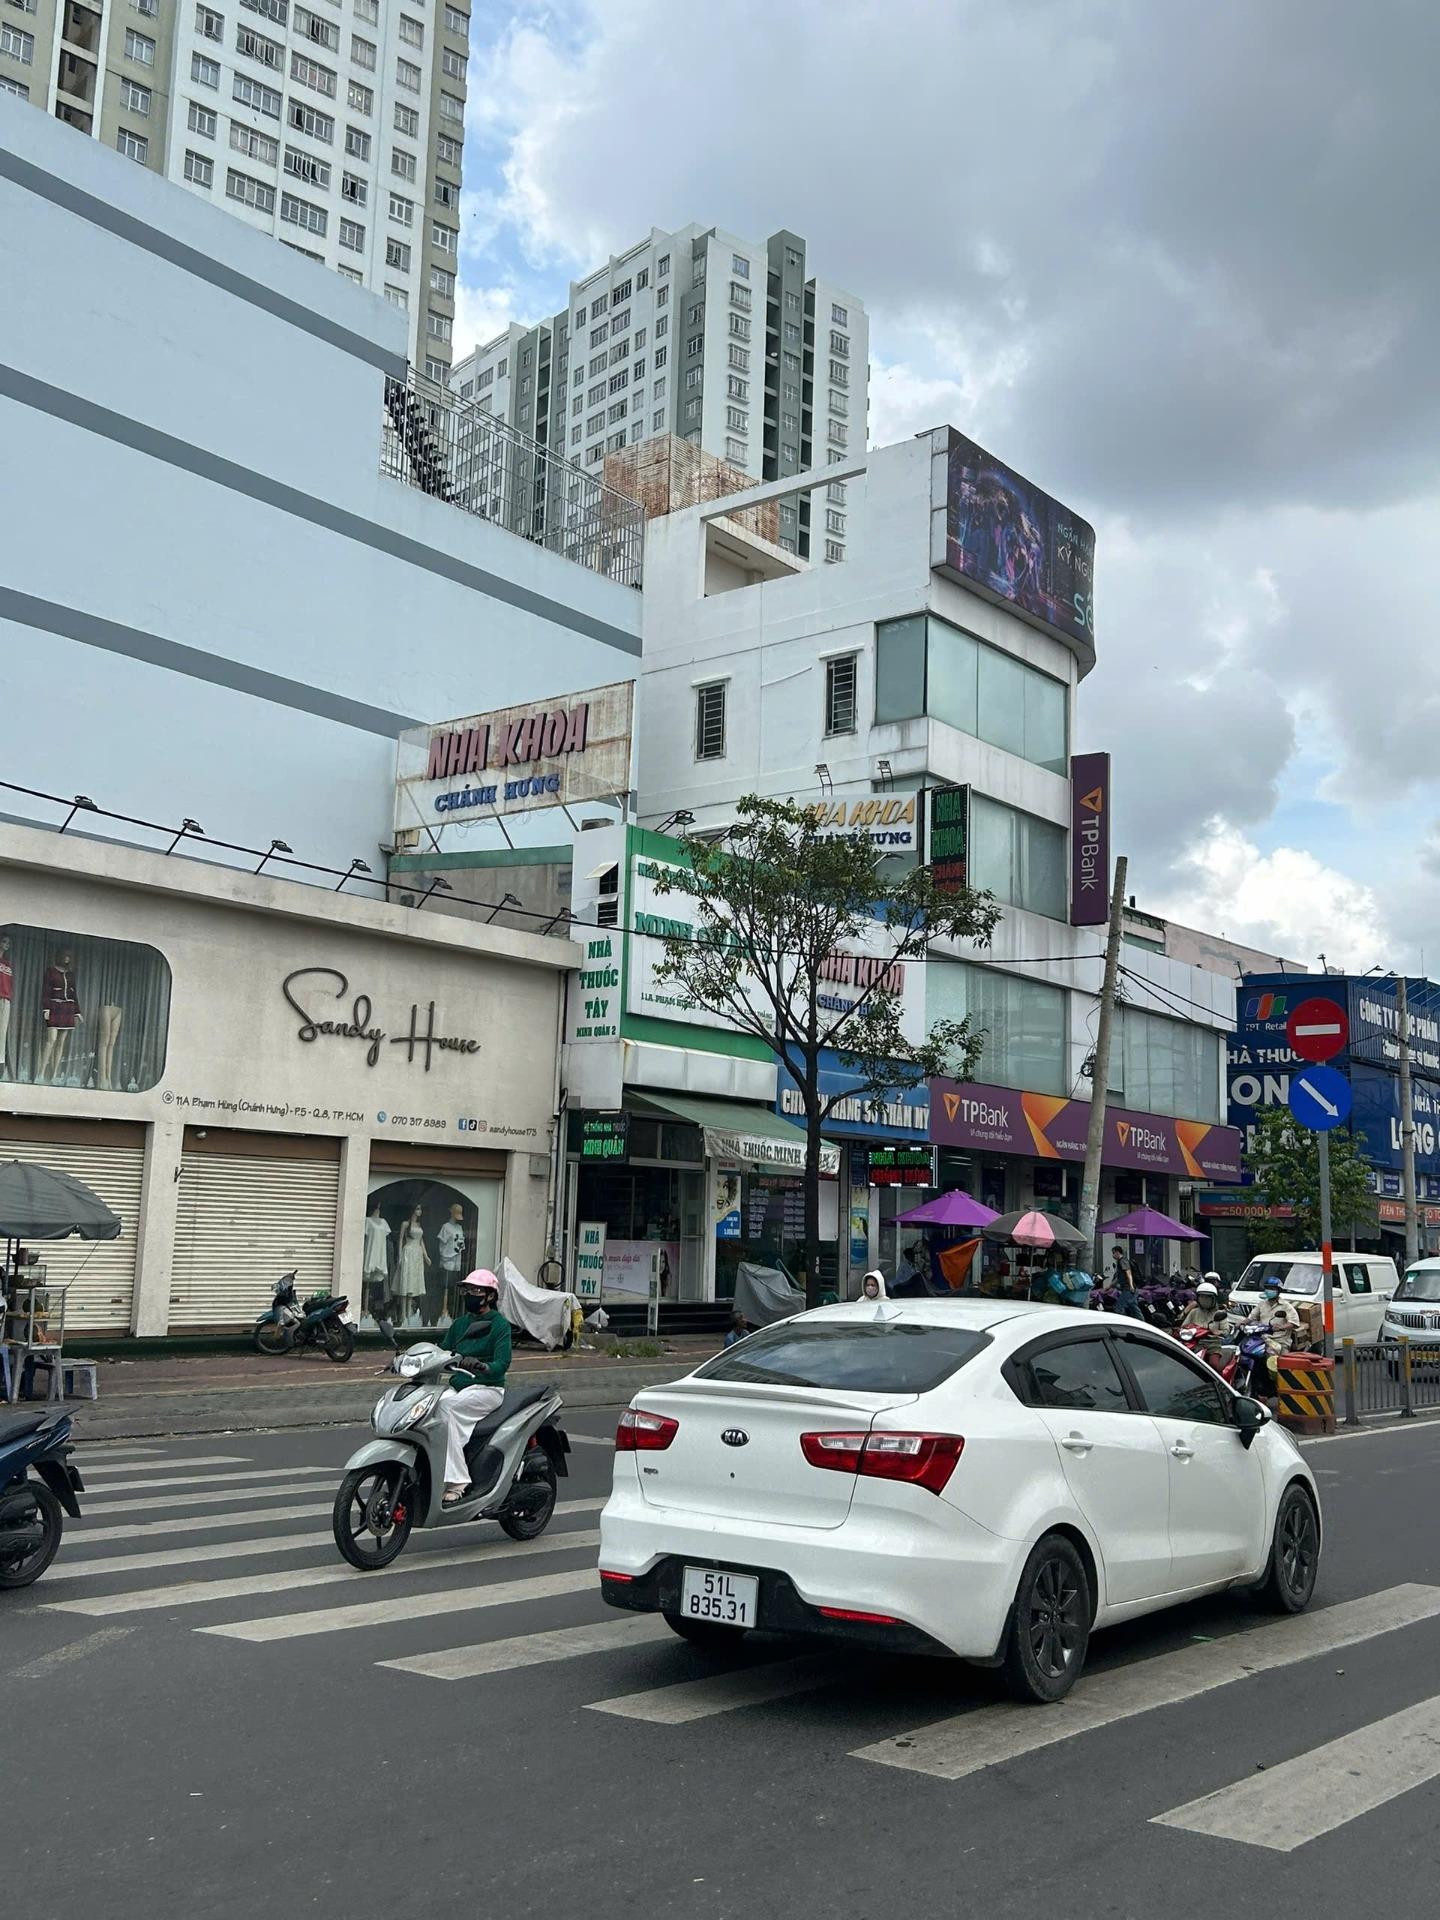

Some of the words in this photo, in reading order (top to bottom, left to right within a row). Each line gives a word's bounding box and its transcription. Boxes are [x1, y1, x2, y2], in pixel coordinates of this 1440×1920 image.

[427, 725, 490, 780] NHA
[499, 703, 589, 768] KHOA
[434, 784, 497, 812] CHÁNH
[807, 803, 846, 827] HA
[849, 797, 915, 827] KHOA
[1081, 816, 1099, 890] TPBank
[634, 911, 693, 942] MINH
[588, 936, 612, 959] NHÀ
[579, 963, 618, 989] THUỐC
[283, 967, 386, 1067] Sandy
[390, 1001, 481, 1072] House
[585, 997, 608, 1018] TÂY
[1360, 997, 1382, 1026] CÔNG
[1382, 1006, 1393, 1030] TY
[611, 1025, 616, 1035] 2
[1227, 1044, 1252, 1064] HÀ
[176, 1095, 190, 1106] 11A
[391, 1115, 407, 1125] 070
[409, 1116, 422, 1126] 317
[424, 1118, 446, 1129] 8989
[961, 1099, 1008, 1128] TPBank
[1414, 1094, 1431, 1113] NHÀ
[743, 1139, 772, 1159] THUỐC
[774, 1145, 802, 1163] MINH
[1130, 1127, 1166, 1151] TPBank
[584, 1227, 600, 1244] NHÀ
[578, 1250, 604, 1269] THUỐC
[581, 1276, 597, 1294] TÂY
[724, 1431, 744, 1444] KIA
[704, 1573, 735, 1597] 51L
[690, 1594, 746, 1622] 835.31
